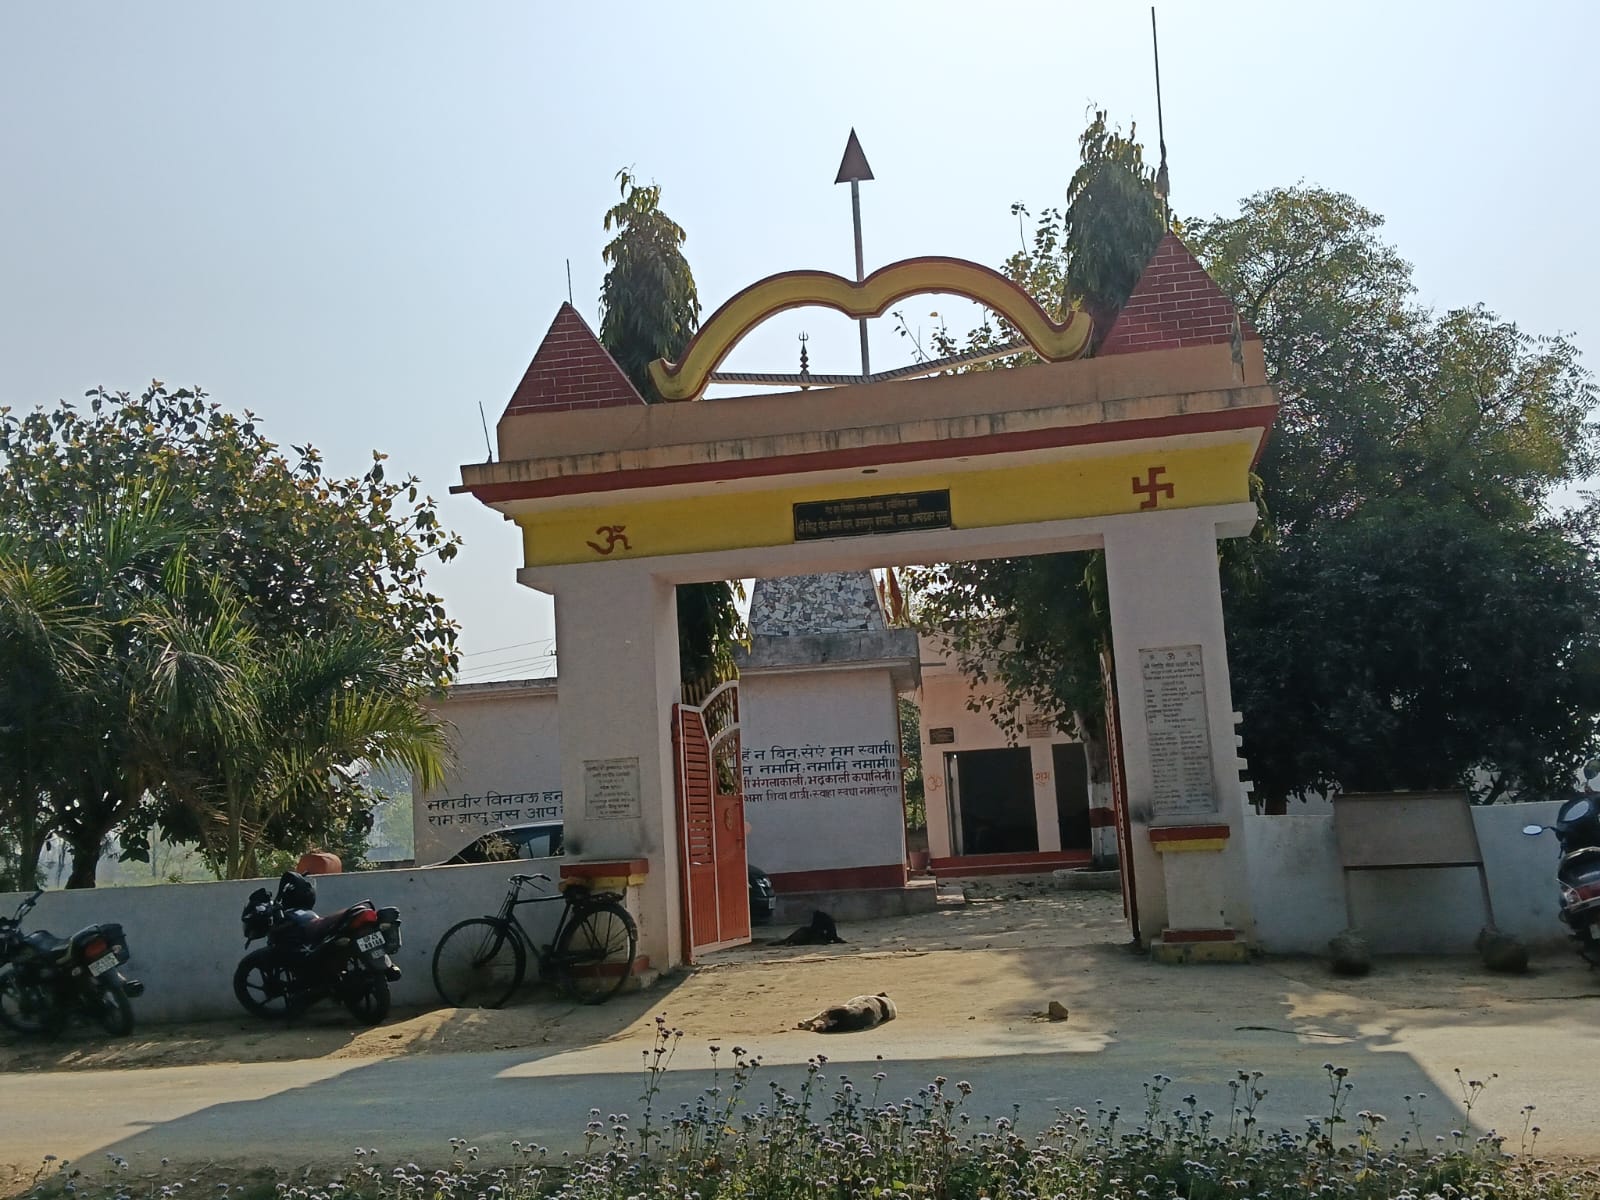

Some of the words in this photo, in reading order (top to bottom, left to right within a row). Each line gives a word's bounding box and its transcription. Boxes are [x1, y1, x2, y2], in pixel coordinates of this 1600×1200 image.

[806, 757, 848, 772] नमामि
[427, 793, 482, 811] महावीर
[428, 814, 455, 826] राम
[525, 806, 557, 819] आप
